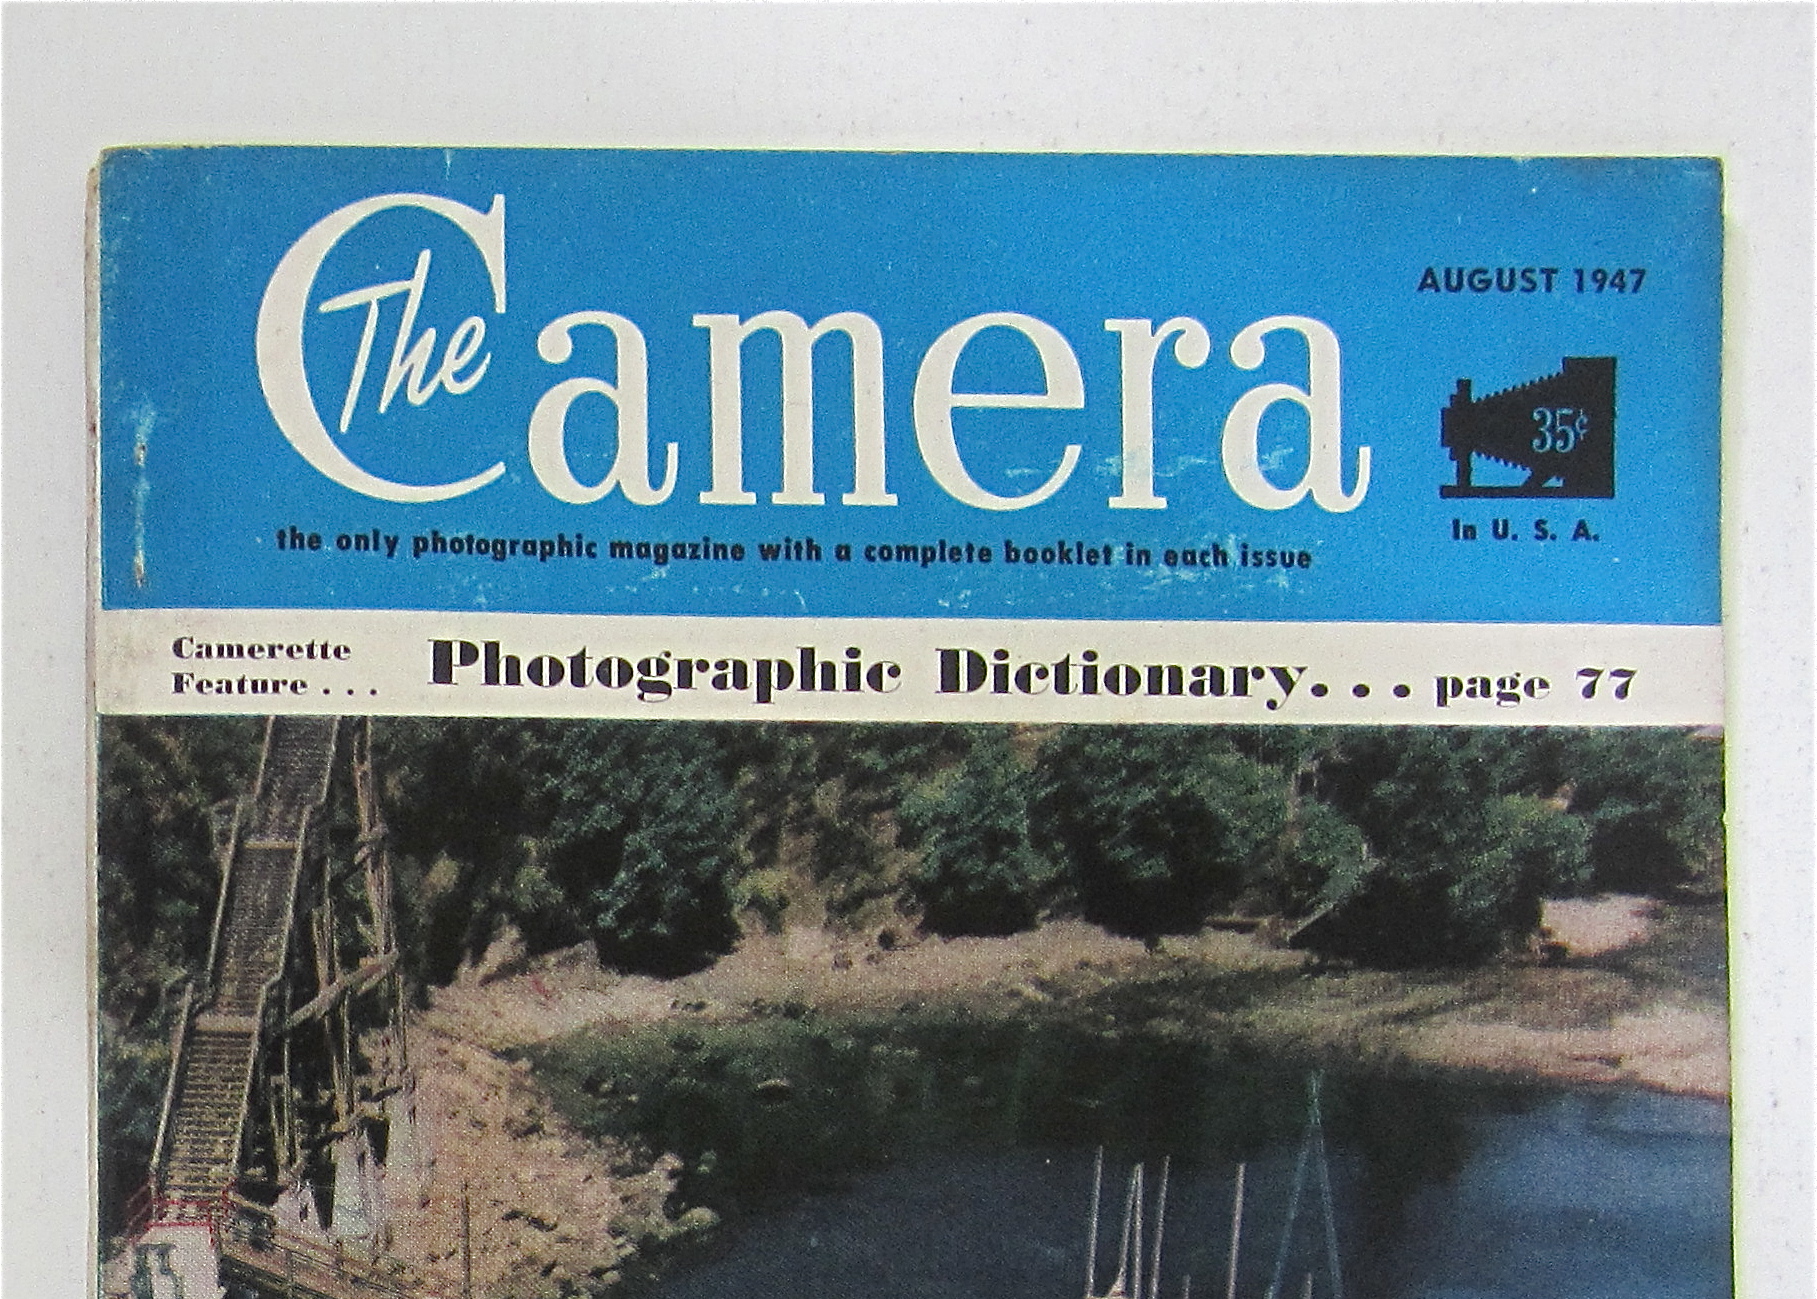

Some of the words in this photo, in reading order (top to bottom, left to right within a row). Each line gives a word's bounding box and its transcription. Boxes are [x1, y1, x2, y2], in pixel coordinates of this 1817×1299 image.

[1417, 267, 1558, 293] AUGUST
[1574, 268, 1646, 293] 1947
[256, 192, 1371, 513] Camera
[318, 248, 492, 433] The
[1452, 519, 1476, 540] In
[277, 526, 321, 551] the
[337, 529, 399, 559] only
[413, 530, 597, 562] photographic
[610, 536, 745, 565] magazine
[758, 537, 821, 561] with
[835, 544, 851, 561] a
[865, 539, 991, 568] complete
[1005, 539, 1112, 566] booklet
[1126, 542, 1150, 567] in
[1164, 542, 1228, 568] each
[1241, 543, 1311, 569] issue
[173, 637, 350, 660] Camerette
[174, 673, 307, 694] Feature
[428, 638, 900, 703] Photographic
[1437, 673, 1549, 707] page
[1577, 668, 1636, 699] 77
